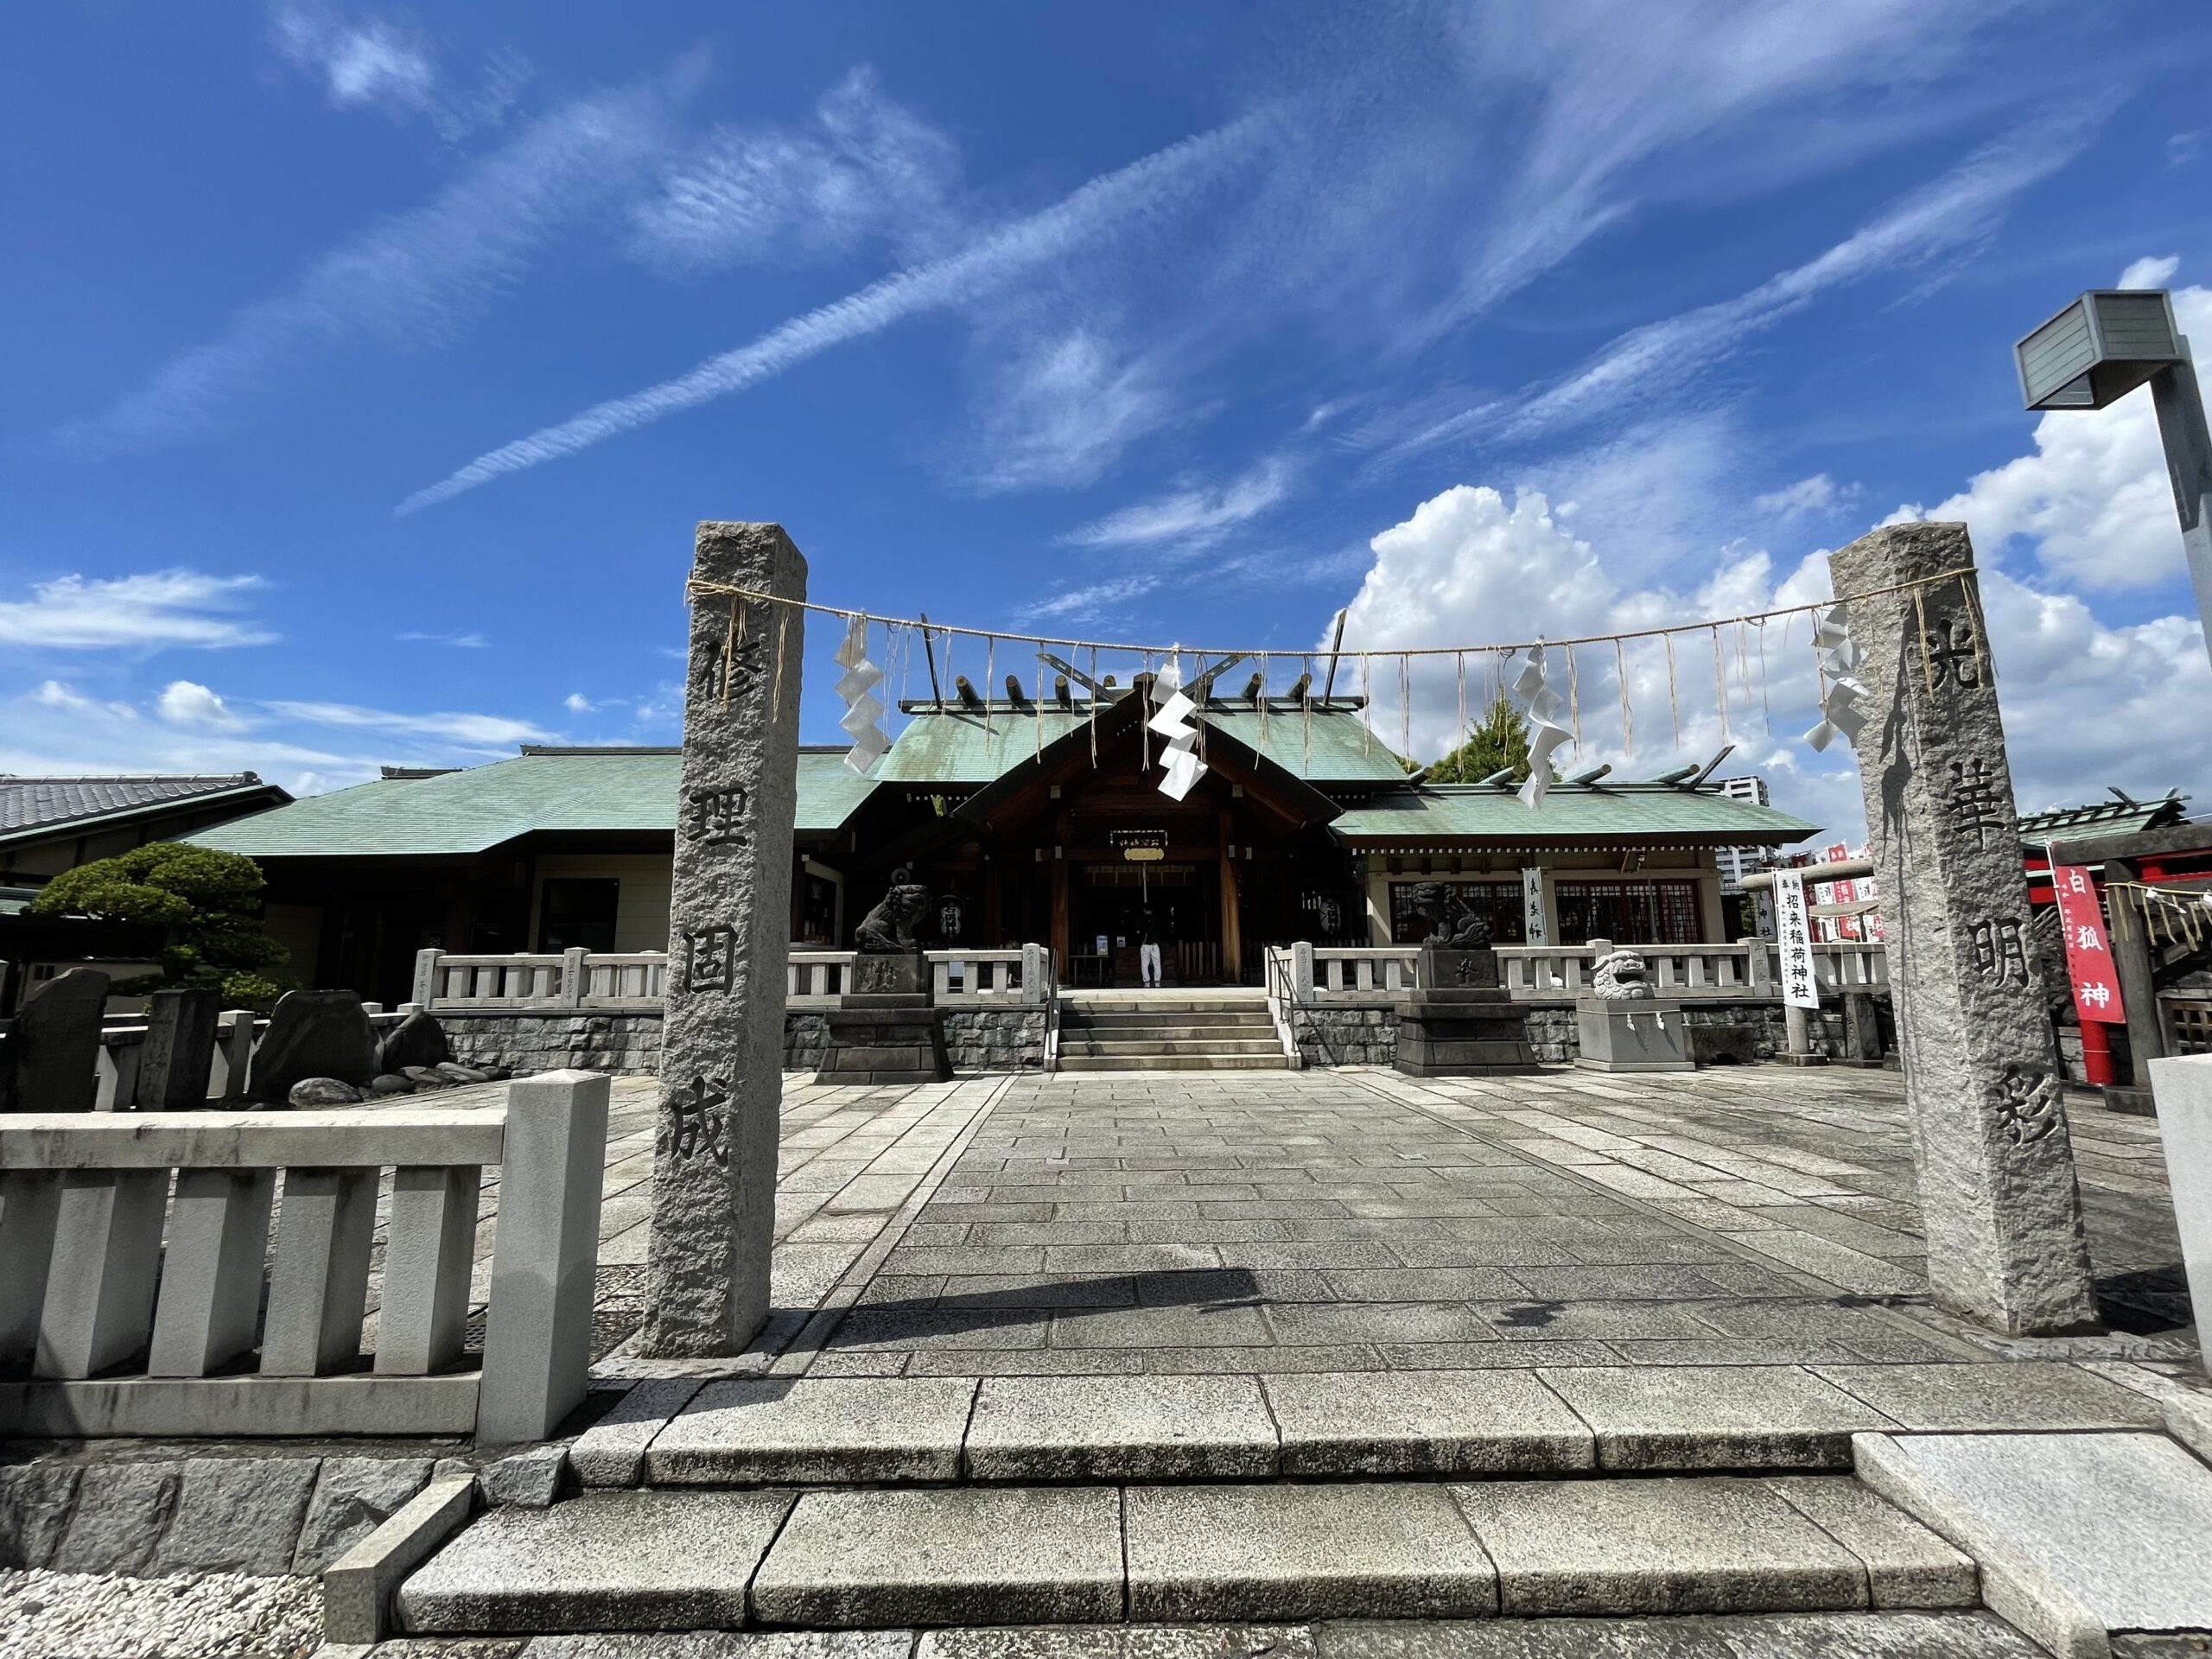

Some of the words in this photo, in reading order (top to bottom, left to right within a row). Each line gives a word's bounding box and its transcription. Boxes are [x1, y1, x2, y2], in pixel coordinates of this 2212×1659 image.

[670, 638, 762, 1168] 修理固成
[1782, 878, 1801, 892] 奉納
[1786, 893, 1811, 999] 招来稲荷神社
[1929, 619, 2058, 1146] 光華明彩
[2068, 868, 2111, 1009] 白狐神
